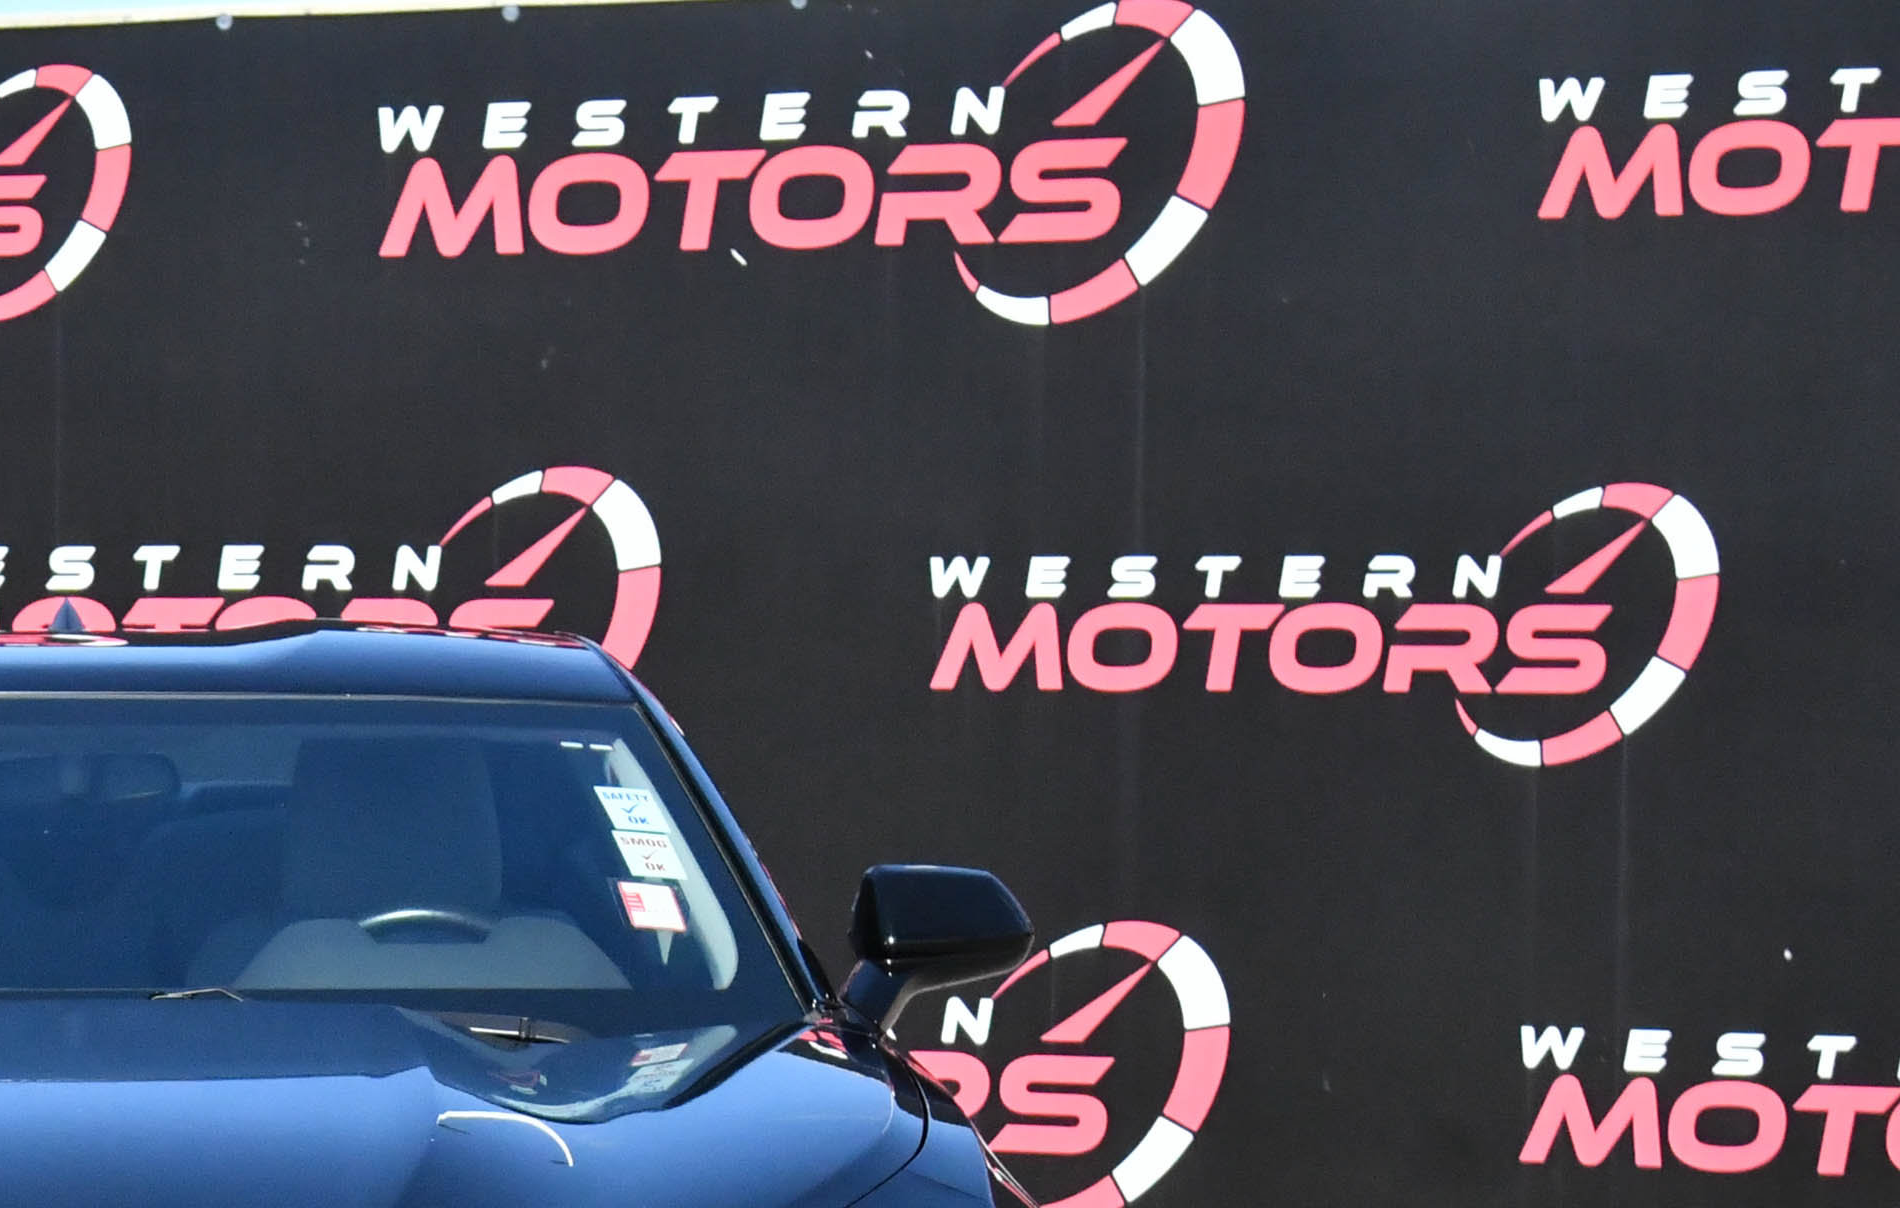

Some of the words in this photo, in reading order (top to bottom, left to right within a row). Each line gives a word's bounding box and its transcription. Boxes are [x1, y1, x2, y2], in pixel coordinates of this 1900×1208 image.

[377, 95, 1007, 154] WESTERN
[379, 134, 1129, 253] MOTORS
[928, 554, 1502, 599] WESTERN
[929, 601, 1615, 696] MOTORS
[601, 790, 650, 803] SAFETY
[620, 836, 668, 849] SMOG
[1520, 1024, 1900, 1081] WEST
[1518, 1073, 1900, 1178] MOT
